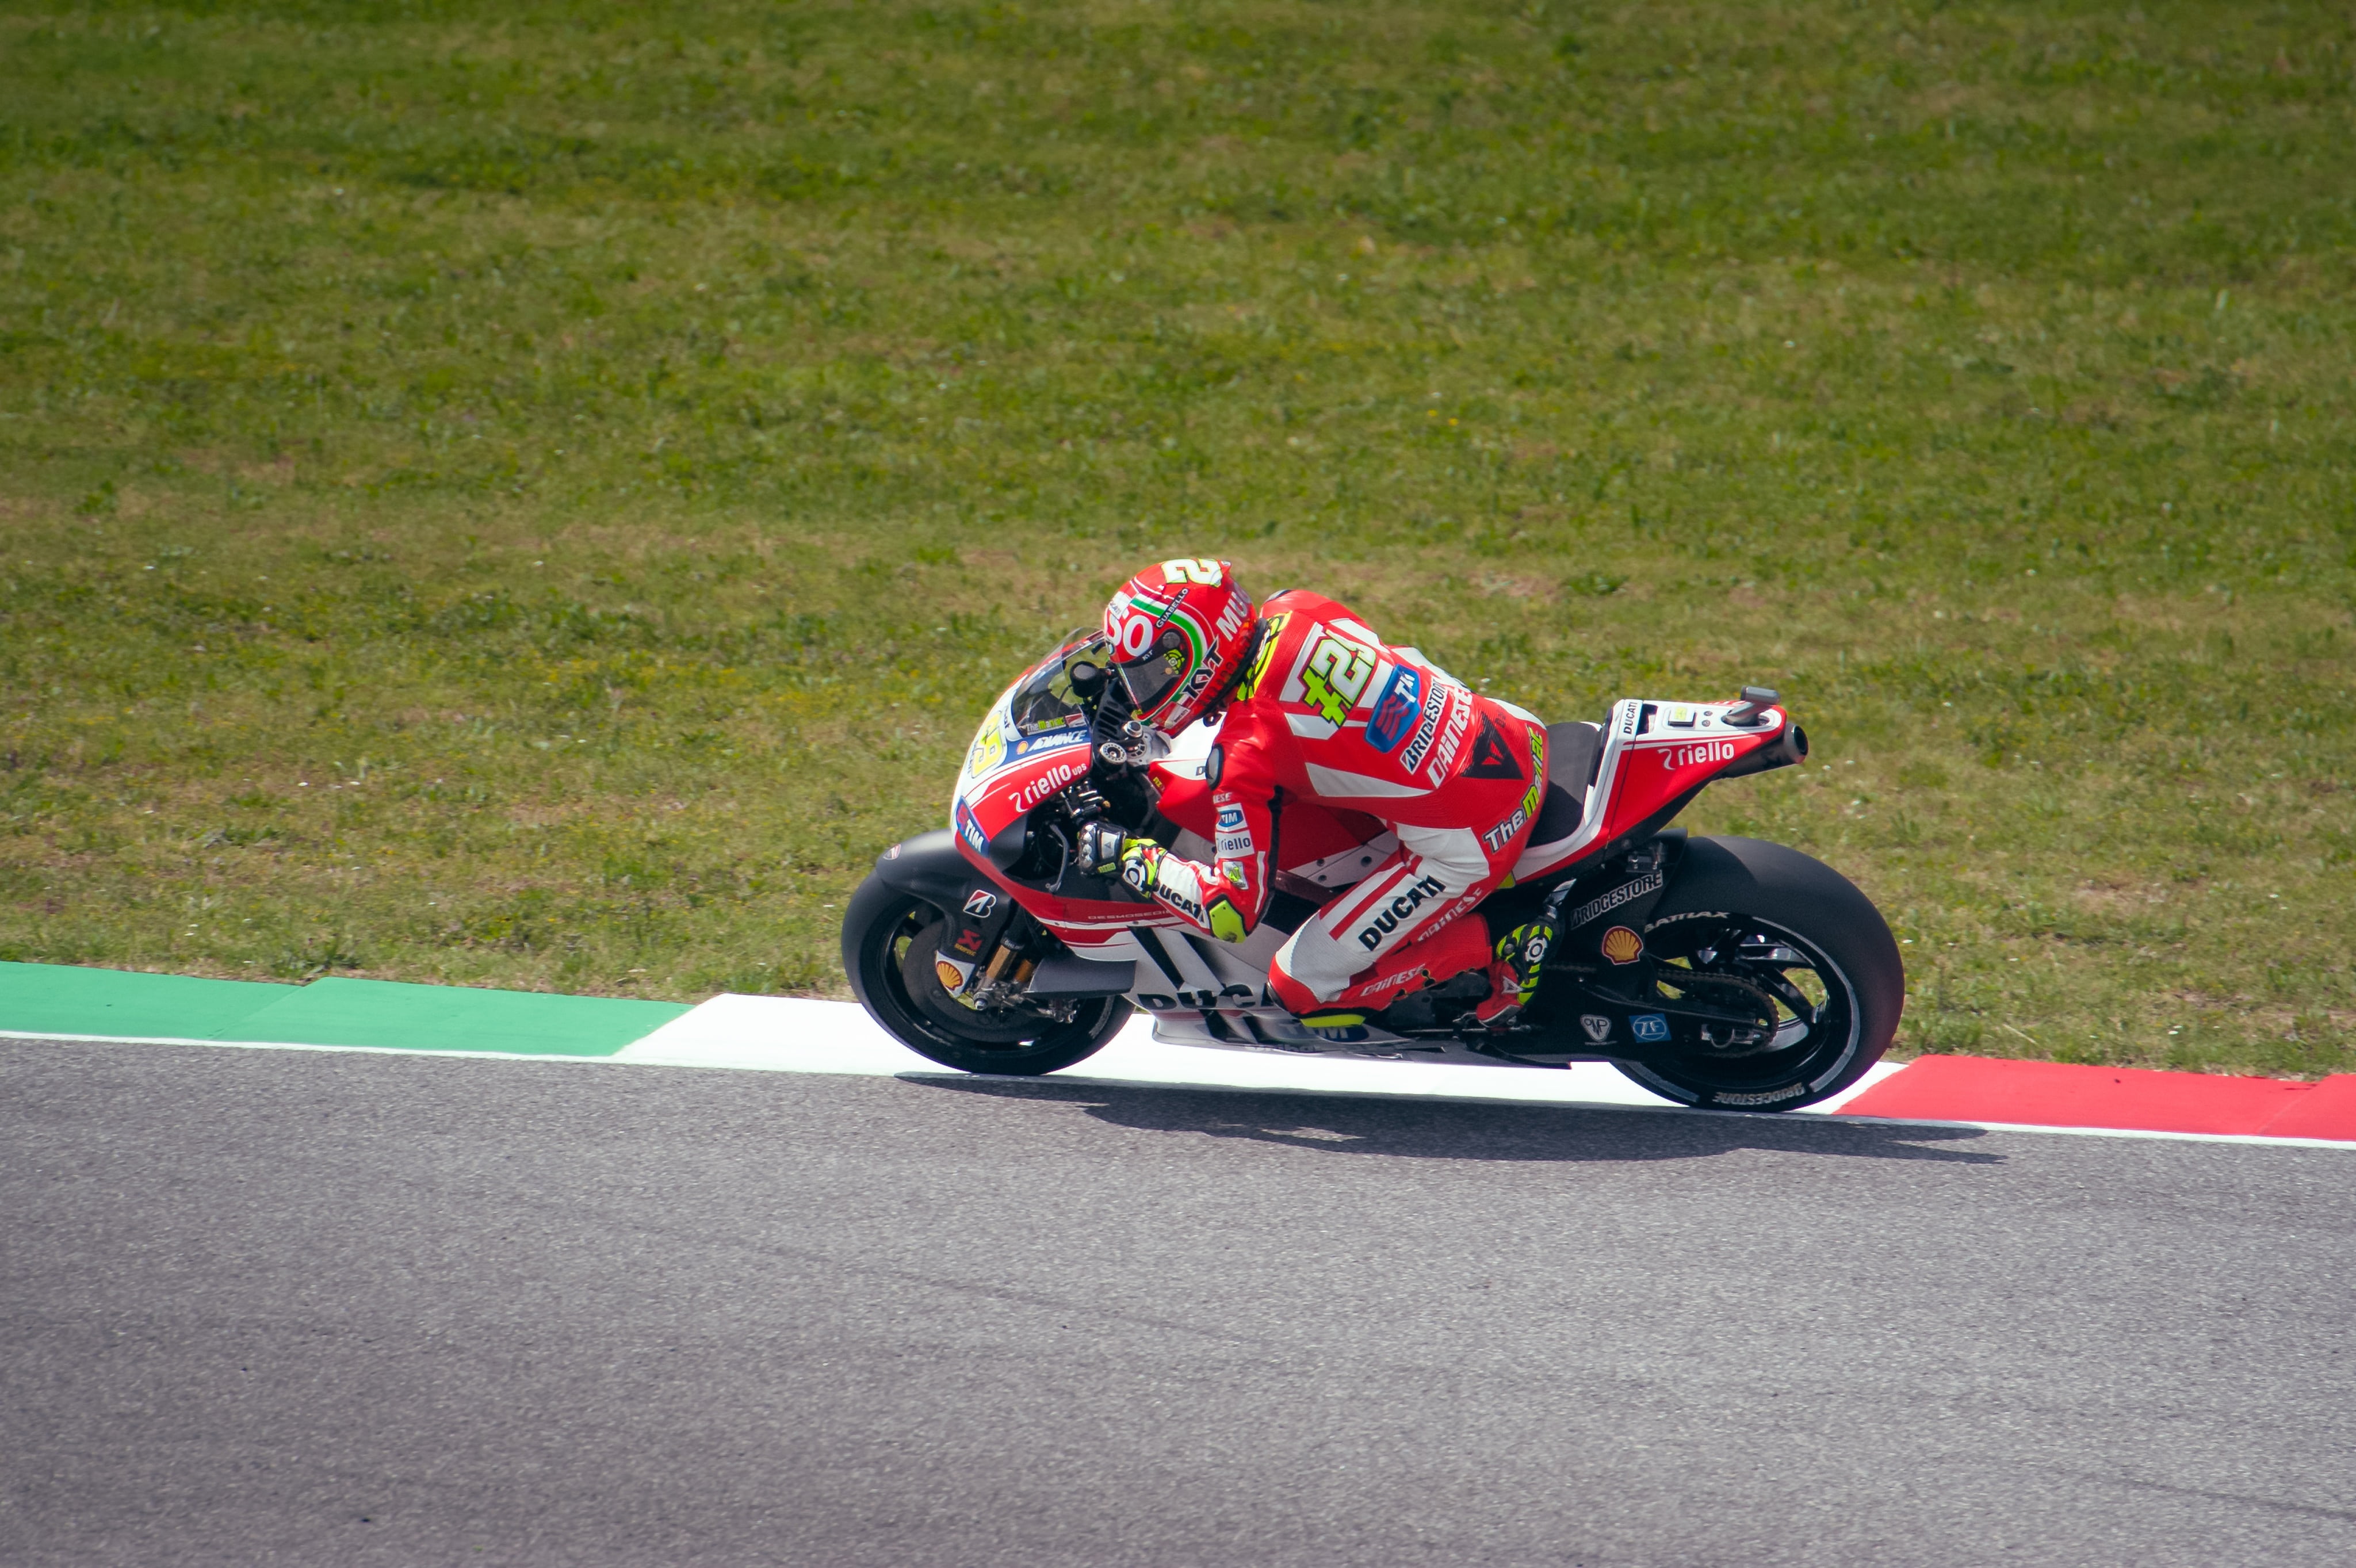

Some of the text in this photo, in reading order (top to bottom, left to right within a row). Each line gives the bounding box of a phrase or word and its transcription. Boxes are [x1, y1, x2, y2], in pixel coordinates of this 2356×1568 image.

[1156, 588, 1188, 628] GUABELLO
[1623, 701, 1638, 735] DUCATI
[1678, 741, 1735, 766] riello
[1024, 763, 1087, 804] riello ups
[1221, 812, 1238, 824] TIM
[965, 819, 984, 852] TIM
[1358, 875, 1447, 951] DUCATI
[1571, 870, 1663, 930] BRIDGESTONE
[1644, 911, 1731, 933] BATTLAX
[1712, 1081, 1806, 1106] BRIDGESTONE
